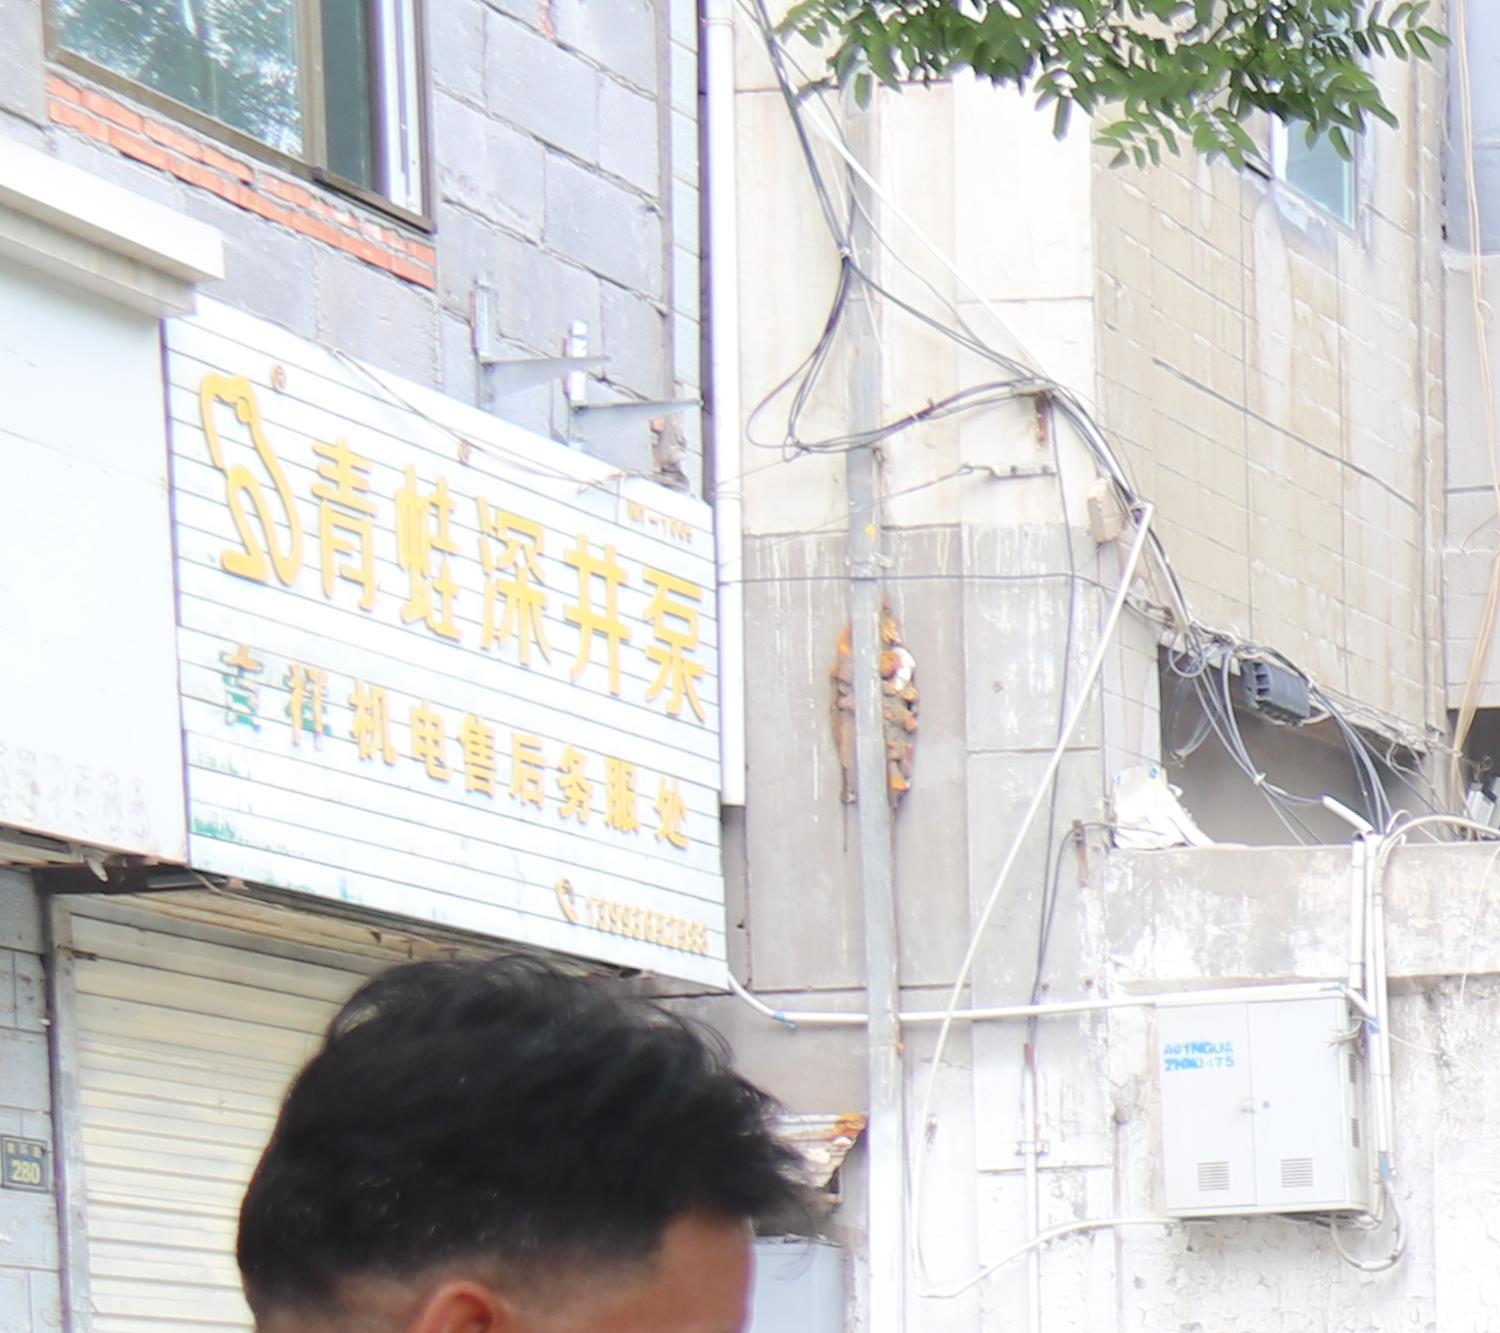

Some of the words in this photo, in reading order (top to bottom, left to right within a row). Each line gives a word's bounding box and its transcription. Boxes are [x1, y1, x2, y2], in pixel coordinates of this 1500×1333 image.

[311, 437, 706, 724] 青蛙深井泵
